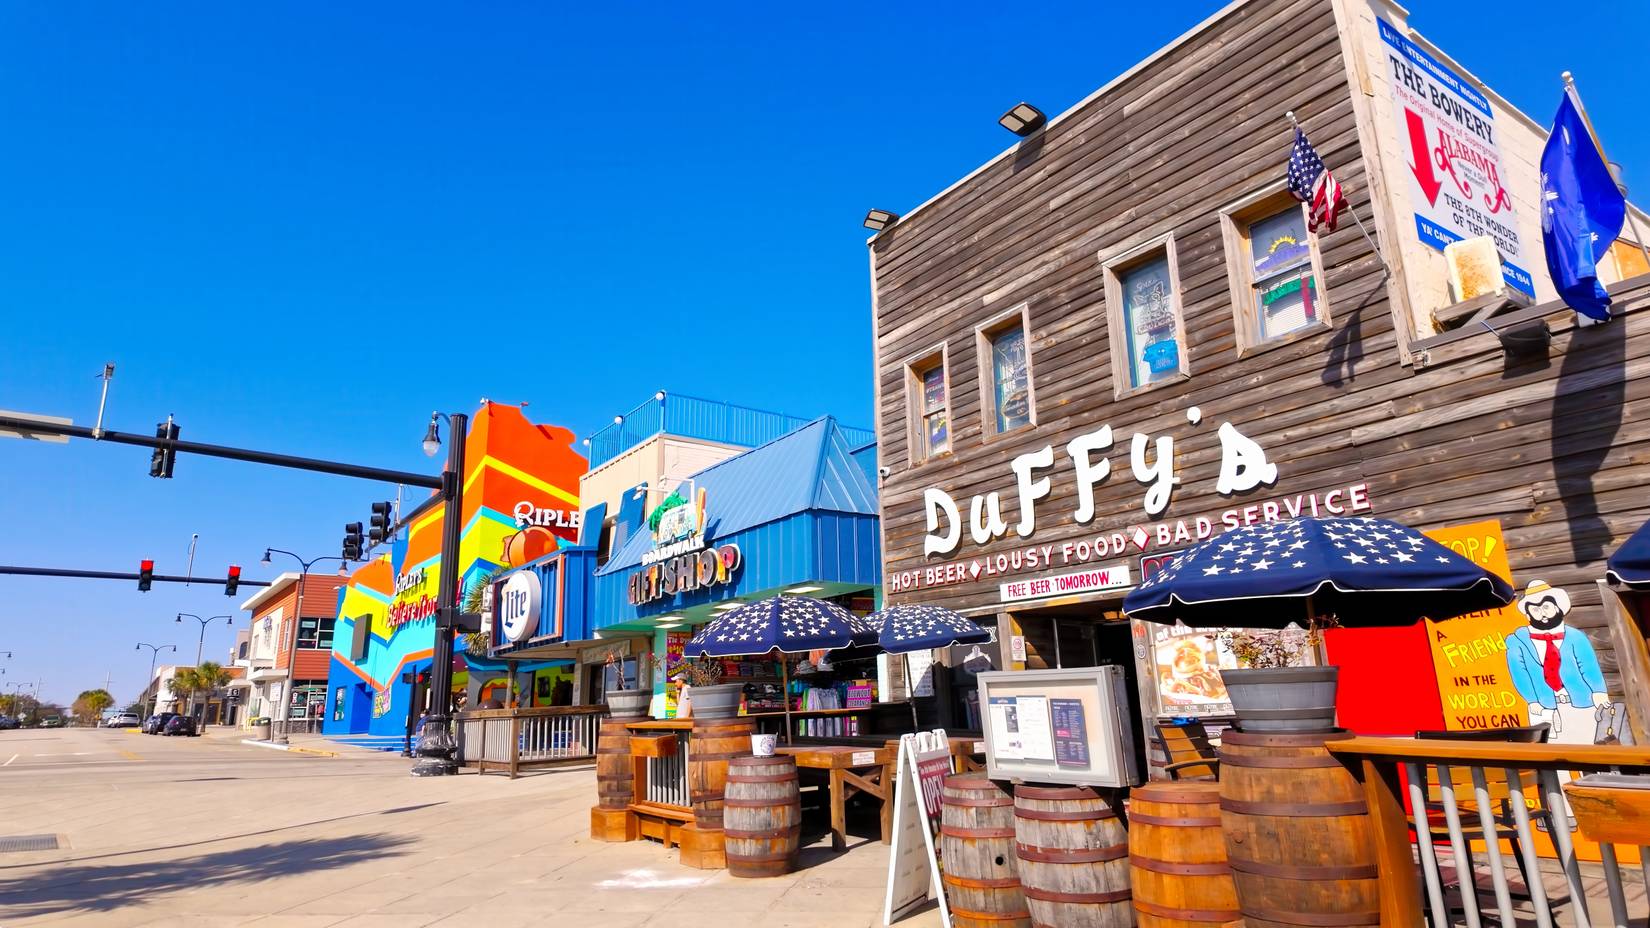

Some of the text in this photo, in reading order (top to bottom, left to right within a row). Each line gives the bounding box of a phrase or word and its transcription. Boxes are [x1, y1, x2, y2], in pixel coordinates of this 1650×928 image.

[1389, 54, 1494, 145] THE BOWERY
[1460, 85, 1488, 110] NIGHTLY
[1394, 84, 1499, 162] The Original Home of Supergroup
[1434, 127, 1511, 214] ALABAMA
[1444, 193, 1519, 244] THE 8TH WONDER
[1453, 213, 1465, 227] OF
[642, 534, 705, 566] BOARDWALK
[892, 482, 1372, 592] HOT BEER LOUSY FOOD BAD SERVICE
[628, 543, 741, 606] GIFT SHOP
[1006, 583, 1027, 598] FREE
[1030, 579, 1051, 595] BEER
[504, 590, 527, 629] Lite
[1436, 630, 1447, 643] A
[1454, 674, 1497, 687] IN THE
[1447, 691, 1517, 711] WORLD
[1456, 713, 1521, 730] YOU CAN
